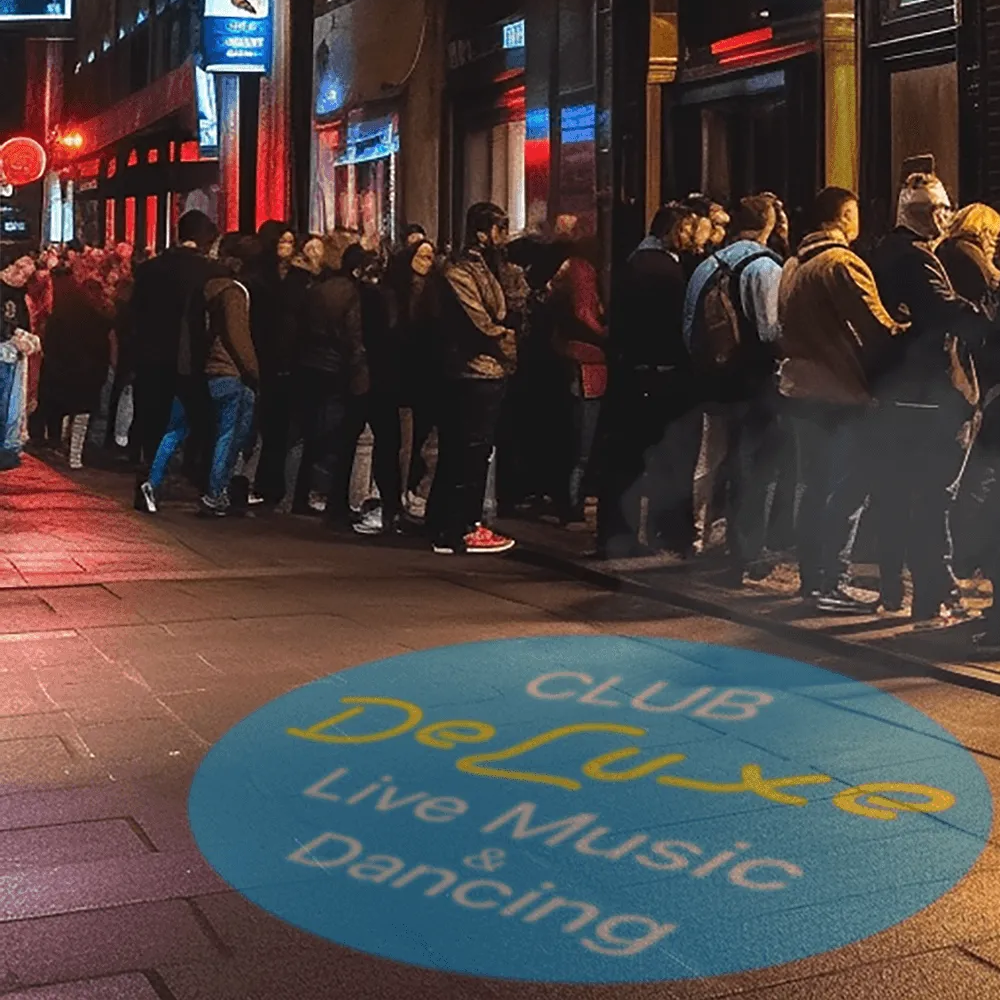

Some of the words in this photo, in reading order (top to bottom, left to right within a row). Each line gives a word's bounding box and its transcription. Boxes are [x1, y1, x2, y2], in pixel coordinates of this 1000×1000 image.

[525, 670, 776, 722] CLUB
[286, 696, 956, 822] DeLuxe
[303, 767, 469, 823] Live
[482, 801, 805, 892] Music
[462, 847, 507, 872] &
[286, 832, 678, 957] Dancing
